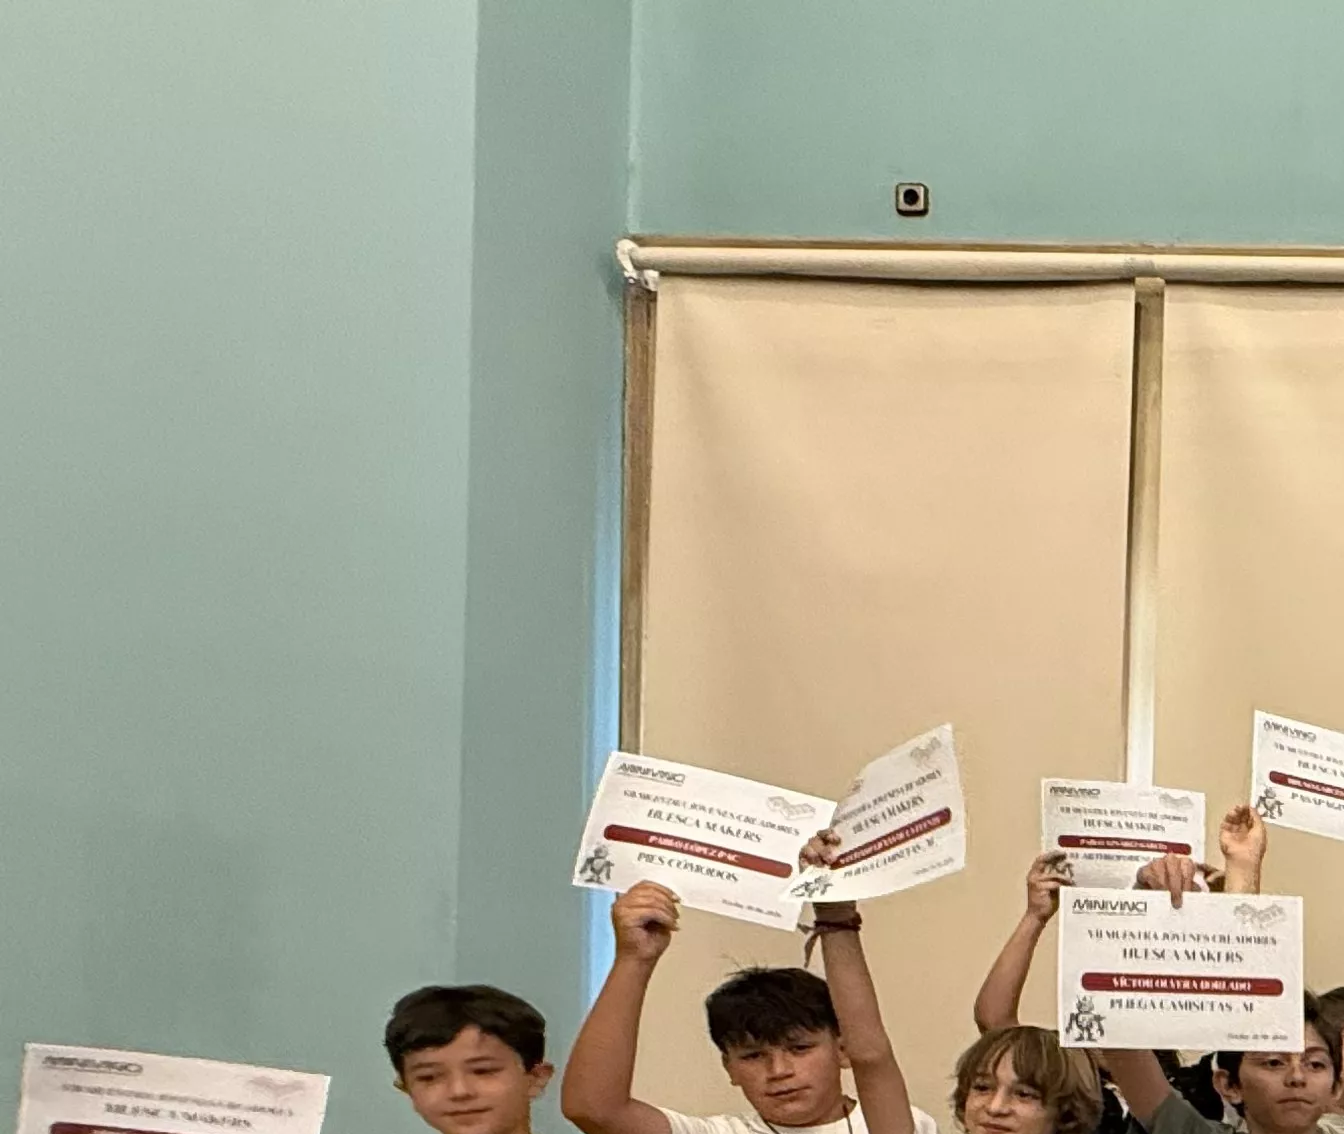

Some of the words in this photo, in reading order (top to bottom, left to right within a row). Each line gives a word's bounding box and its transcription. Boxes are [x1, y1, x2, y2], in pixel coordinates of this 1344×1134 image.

[1073, 899, 1147, 912] MINIVINCI
[1123, 949, 1179, 961] HUESCA
[1184, 951, 1243, 963] MAKERS
